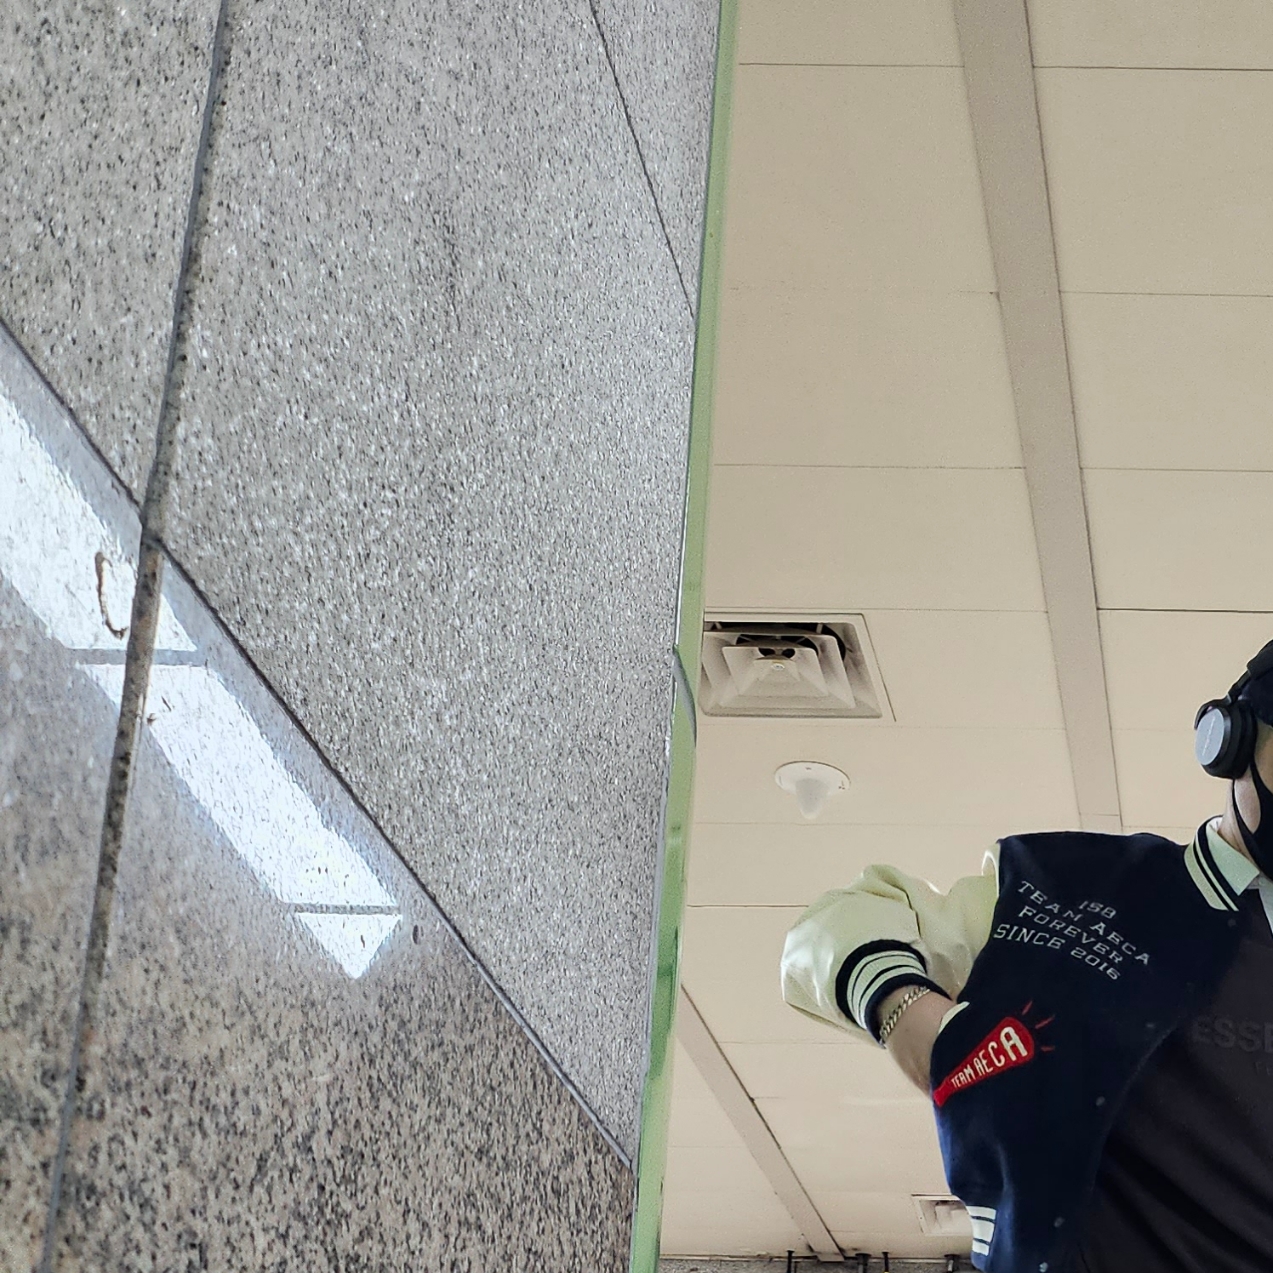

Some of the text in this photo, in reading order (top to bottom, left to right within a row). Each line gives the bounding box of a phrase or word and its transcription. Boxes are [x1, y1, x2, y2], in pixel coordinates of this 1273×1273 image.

[992, 923, 1121, 981] SINCE 2016
[1017, 880, 1151, 966] TEAM AECA
[1018, 905, 1125, 964] FOREVER
[951, 1026, 1028, 1089] TEAM AECA
